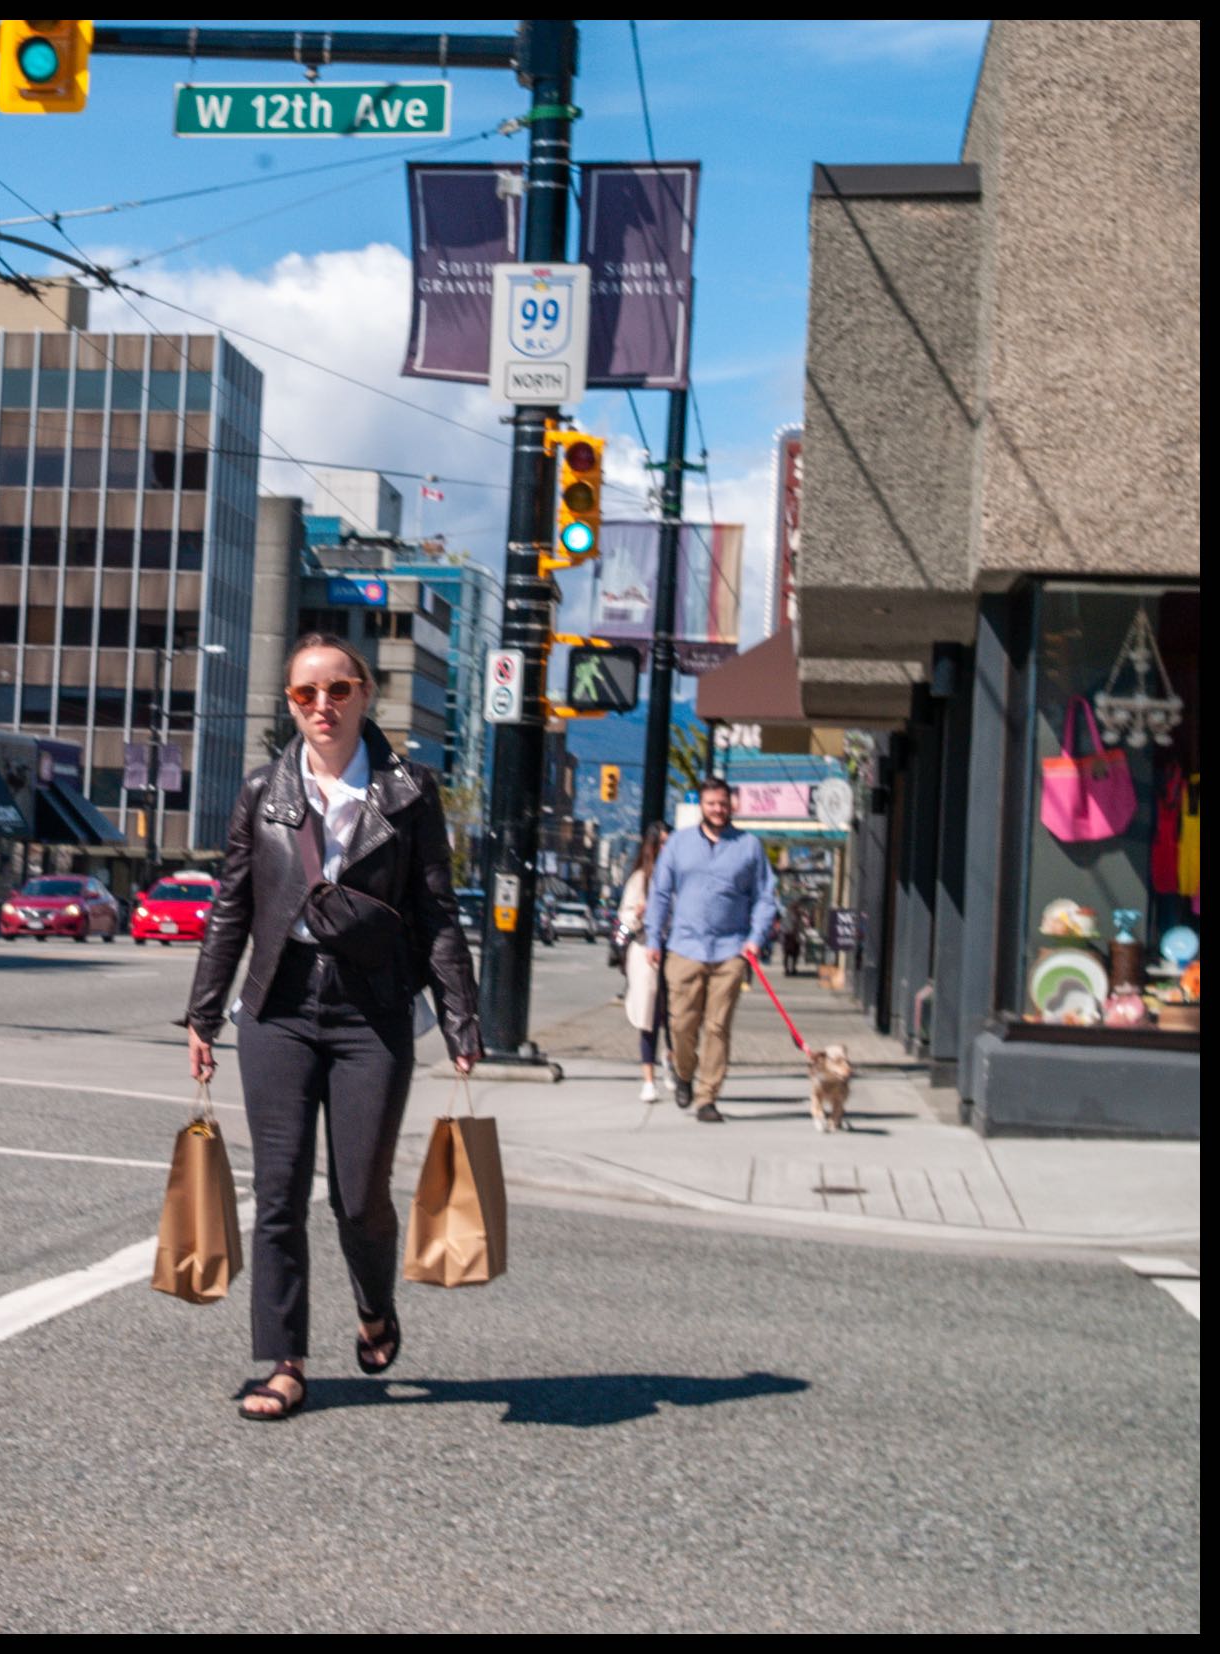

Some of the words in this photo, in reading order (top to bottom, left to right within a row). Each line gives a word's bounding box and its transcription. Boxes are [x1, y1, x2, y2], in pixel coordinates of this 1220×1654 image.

[195, 94, 232, 128] W
[251, 91, 332, 128] 12th
[353, 93, 428, 128] Ave
[604, 260, 668, 277] SOUTH
[418, 277, 493, 296] GRANVIL
[521, 298, 559, 330] 99
[511, 372, 562, 389] NORTH
